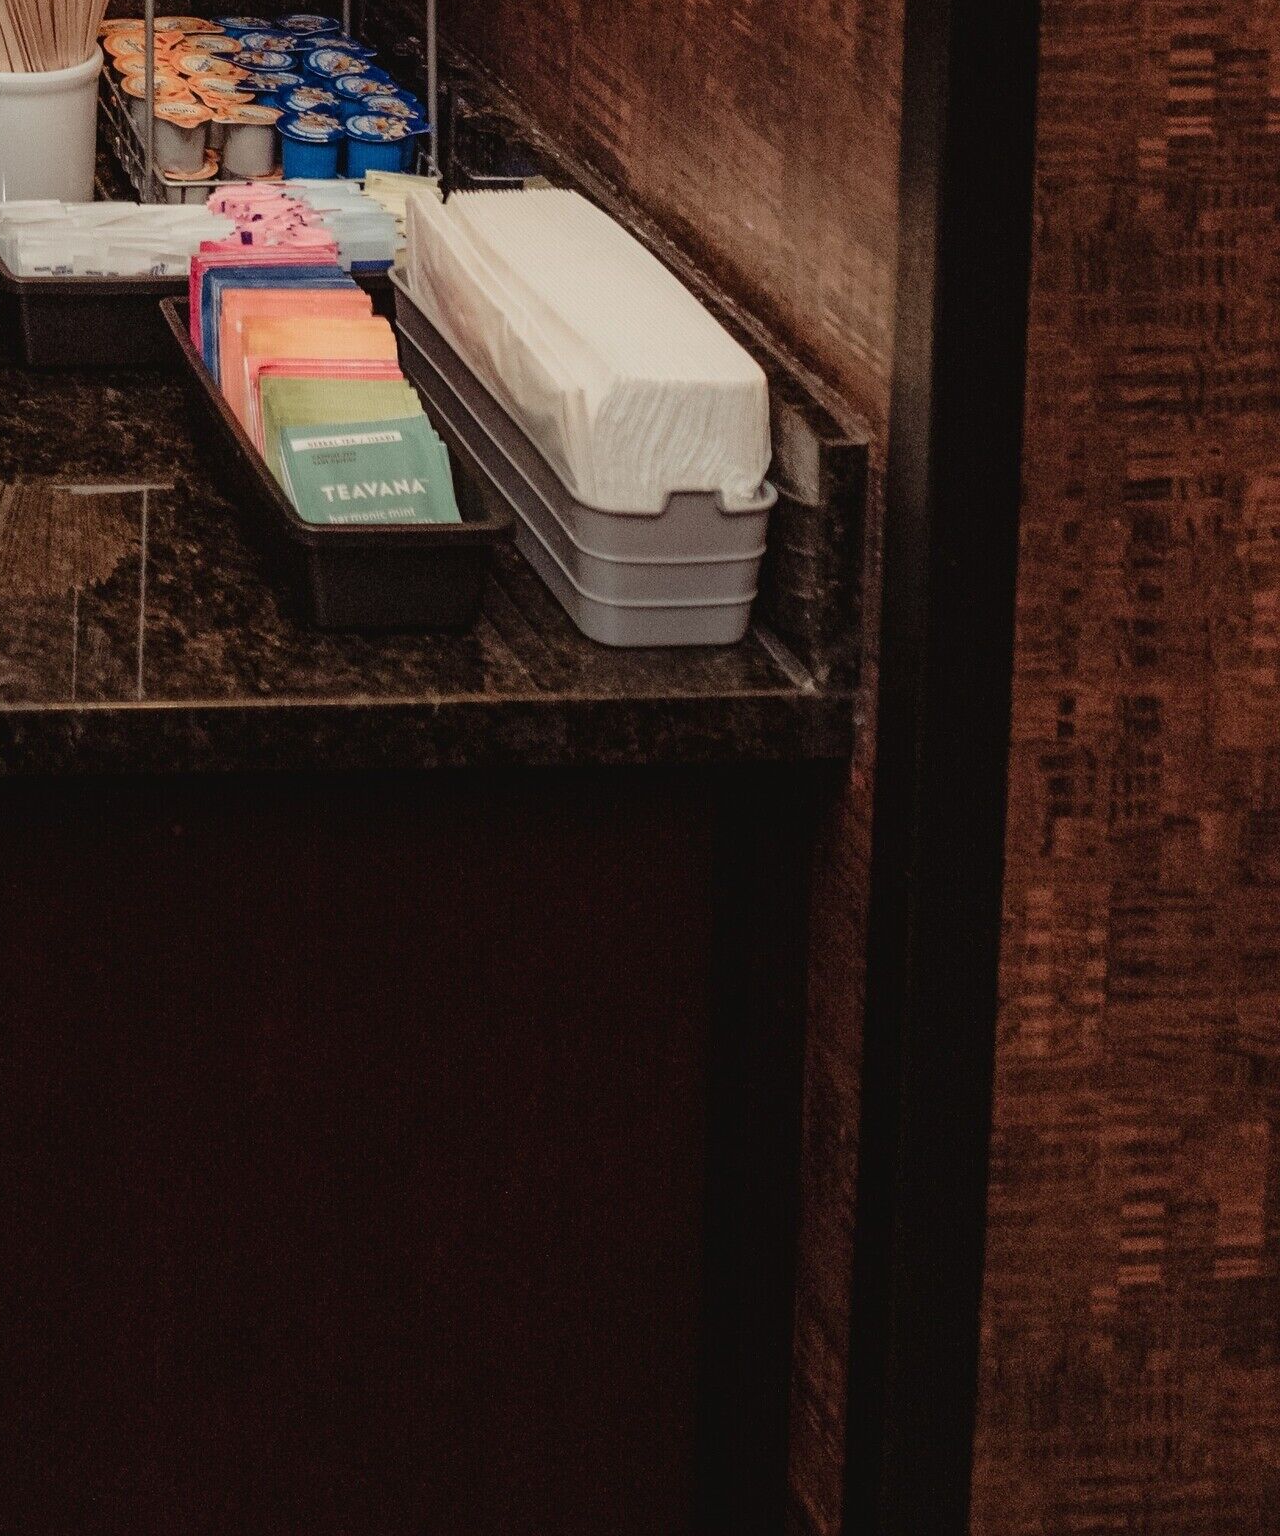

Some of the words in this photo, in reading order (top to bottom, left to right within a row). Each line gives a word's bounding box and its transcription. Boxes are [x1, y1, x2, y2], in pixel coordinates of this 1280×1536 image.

[321, 479, 427, 504] TEAVANA
[328, 510, 387, 524] harmonic
[389, 507, 416, 520] mint
